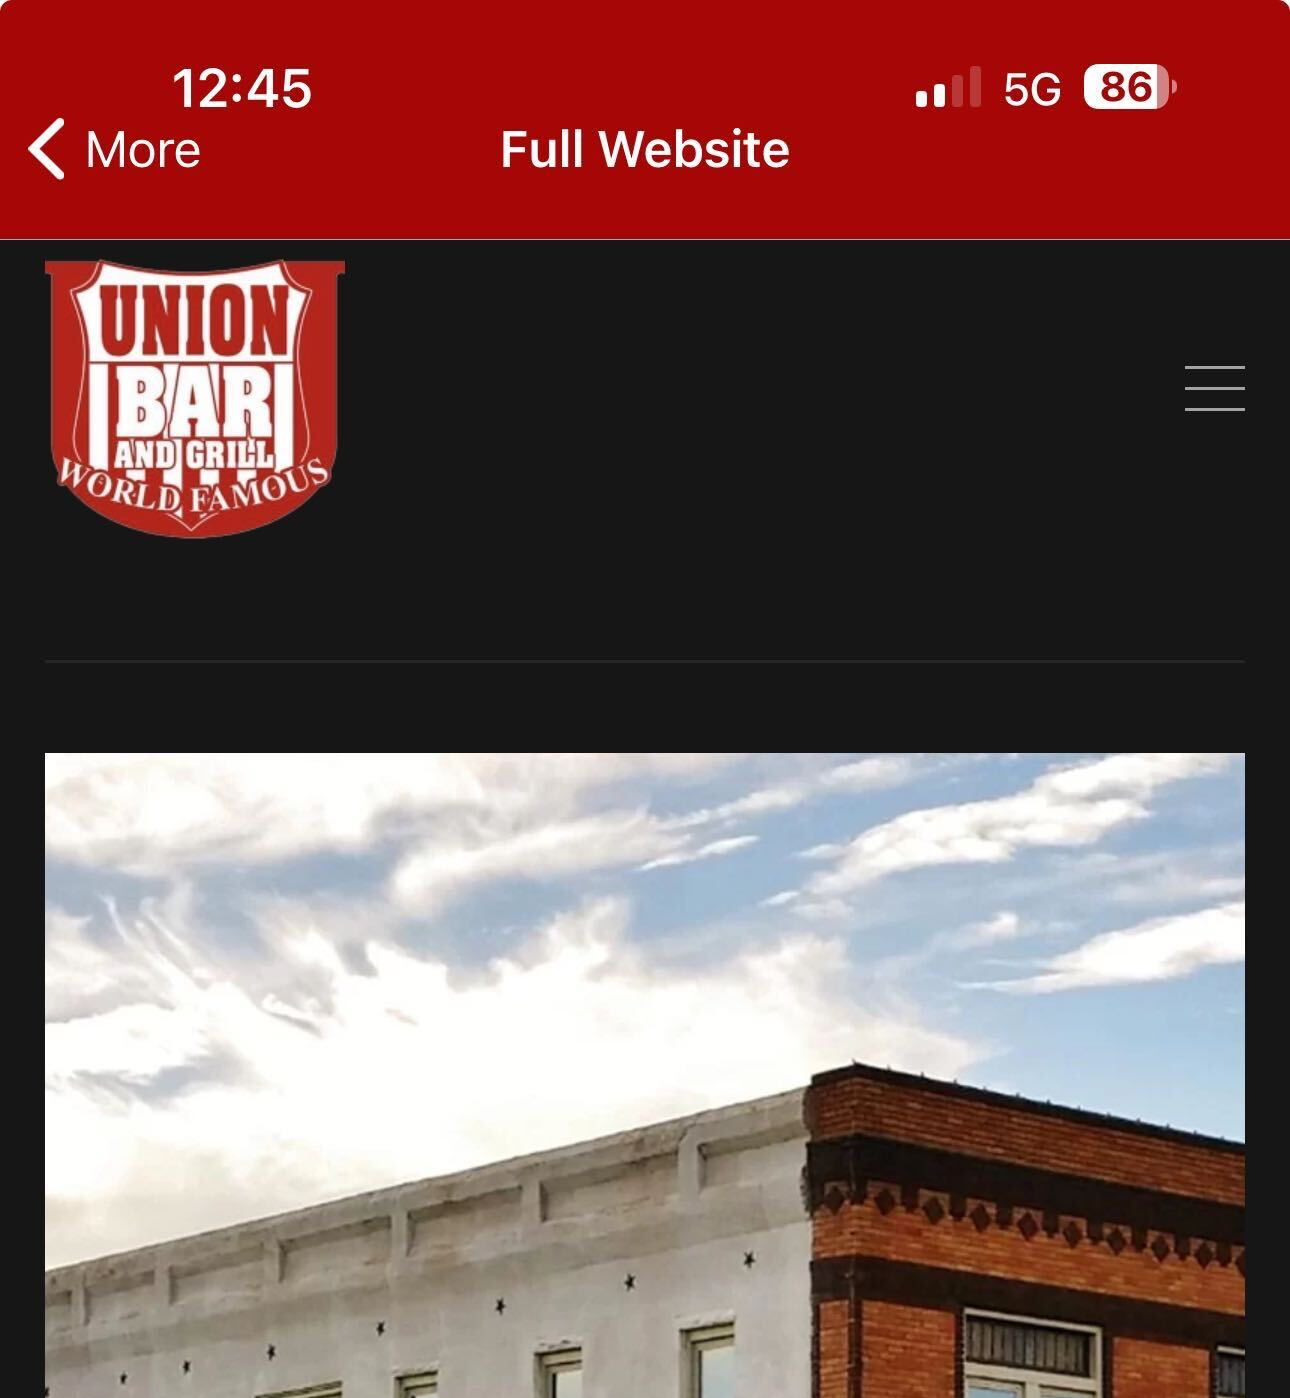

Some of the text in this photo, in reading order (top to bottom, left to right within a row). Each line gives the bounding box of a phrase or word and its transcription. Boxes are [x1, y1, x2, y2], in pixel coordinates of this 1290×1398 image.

[174, 67, 311, 108] 12:45
[1005, 71, 1061, 107] 5G
[1101, 71, 1152, 102] 86
[87, 131, 201, 169] More
[502, 128, 790, 169] Full Website
[100, 283, 290, 357] UNION
[115, 365, 273, 438] BAR
[114, 440, 275, 470] AND GRILL
[59, 456, 331, 513] WORLD FAMOUS
